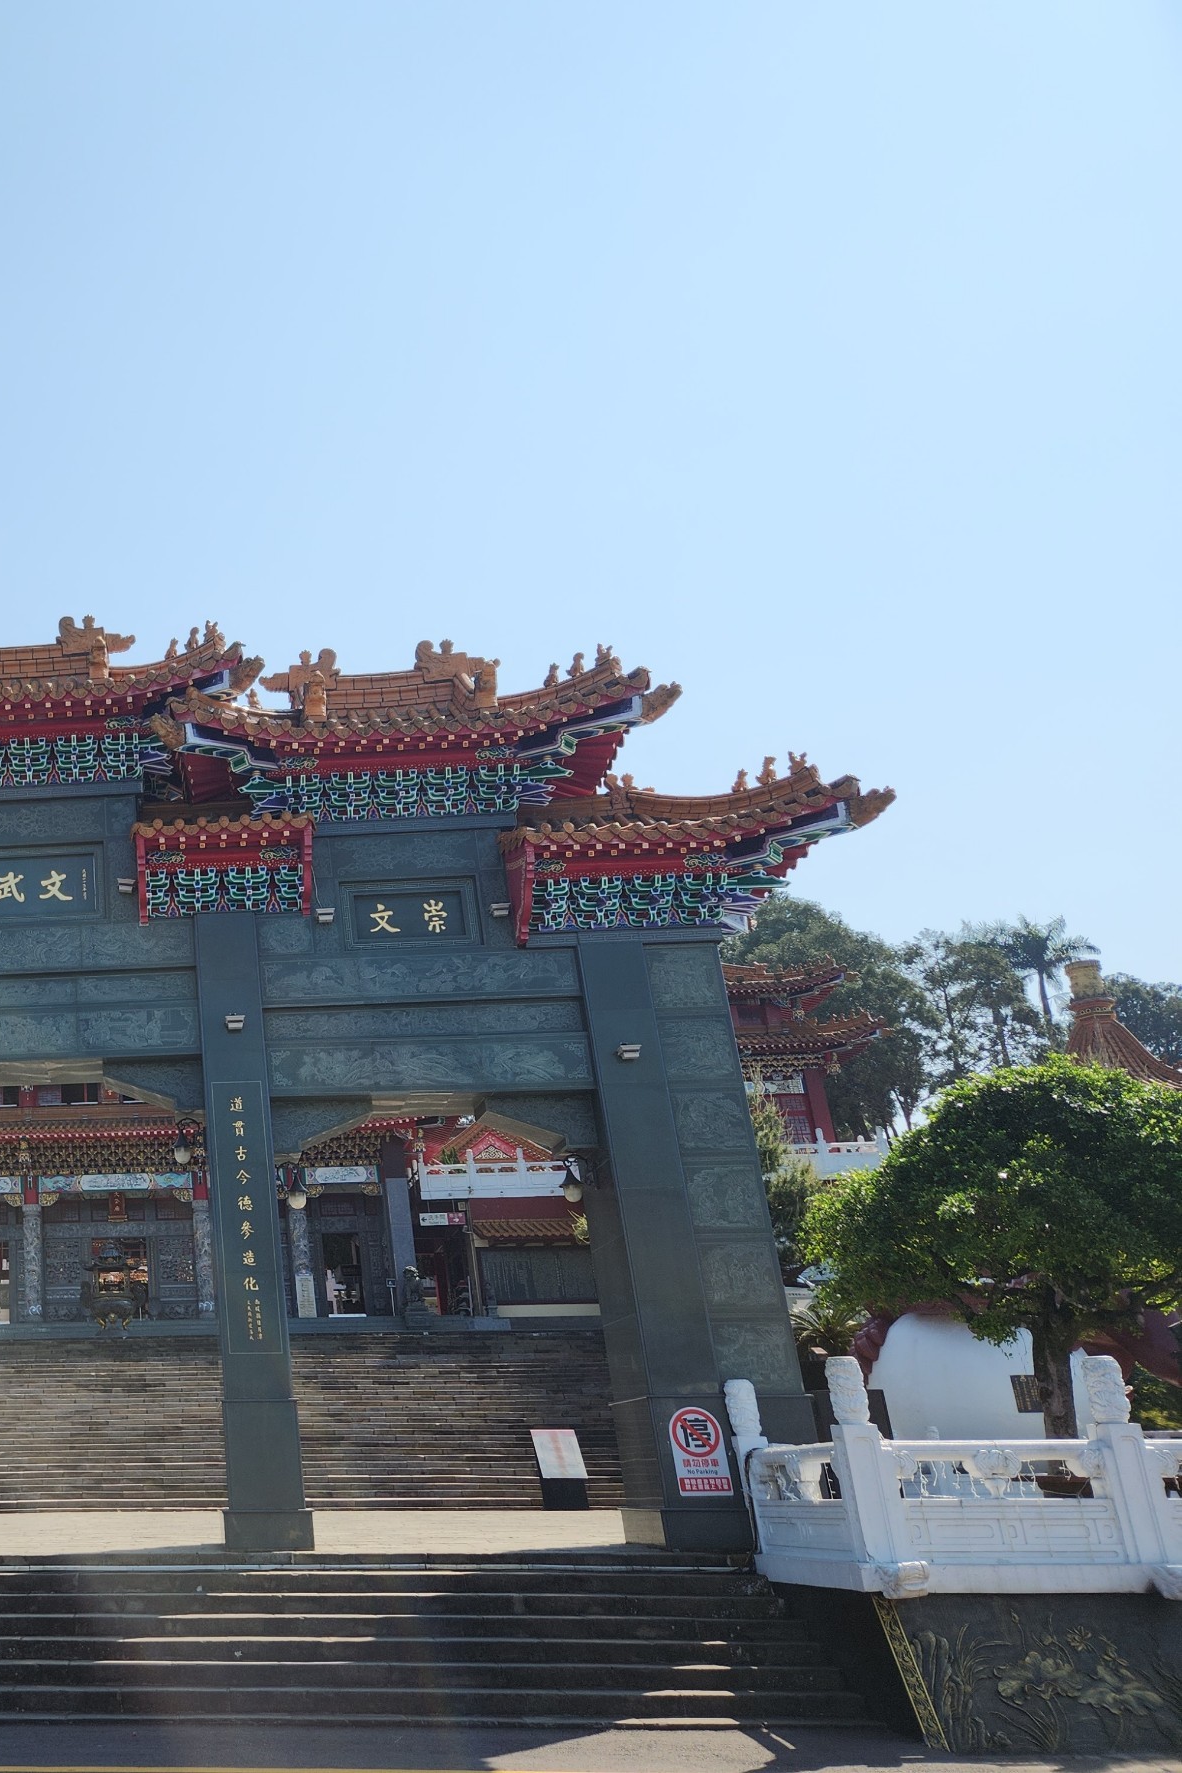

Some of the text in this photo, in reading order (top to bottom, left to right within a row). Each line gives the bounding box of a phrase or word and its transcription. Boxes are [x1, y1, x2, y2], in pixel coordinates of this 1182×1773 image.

[369, 899, 448, 934] 崇文
[229, 1096, 259, 1291] 道貫古今德參造化
[683, 1459, 719, 1467] 請勿停車
